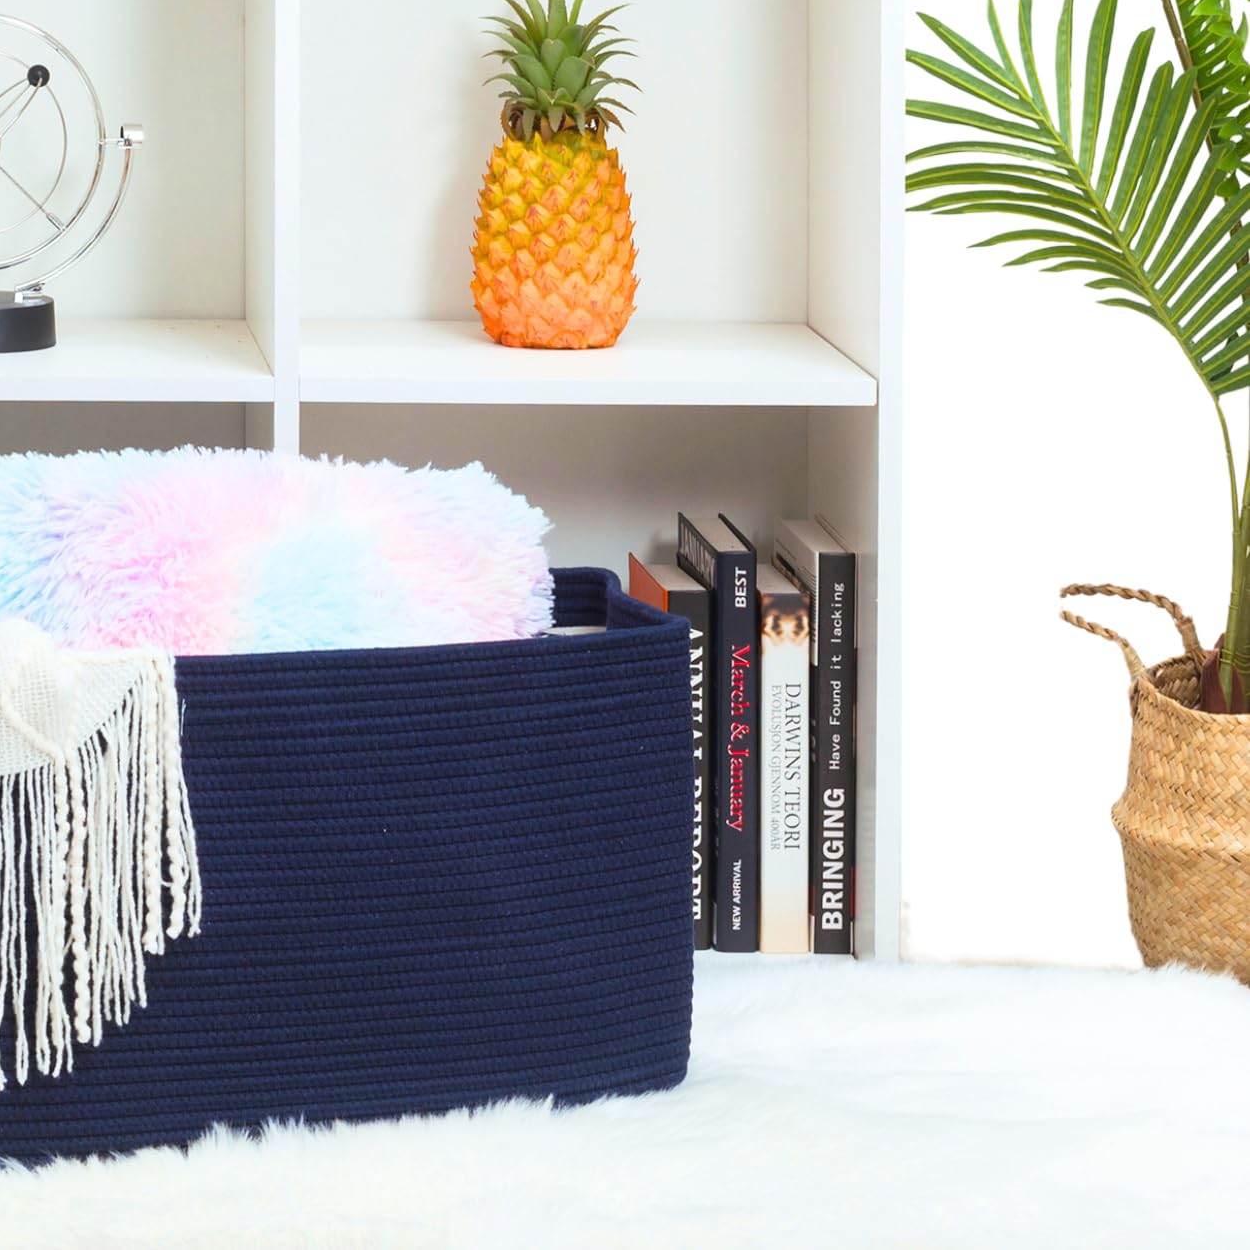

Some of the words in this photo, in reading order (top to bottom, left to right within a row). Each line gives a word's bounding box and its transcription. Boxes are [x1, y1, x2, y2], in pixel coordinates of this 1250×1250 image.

[734, 566, 748, 609] BEST
[830, 582, 846, 644] lacking
[731, 644, 751, 716] March
[830, 655, 842, 671] it
[730, 722, 750, 742] &
[769, 685, 782, 752] EVOLUSJON
[783, 683, 802, 781] DARWINS
[829, 681, 842, 726] Found
[829, 733, 842, 770] Have
[725, 744, 751, 832] January
[769, 755, 782, 813] GJENNOM
[783, 787, 801, 850] TEORI
[732, 859, 742, 904] ARRIVAL
[821, 787, 846, 932] BRINGING
[732, 905, 742, 931] NEW
